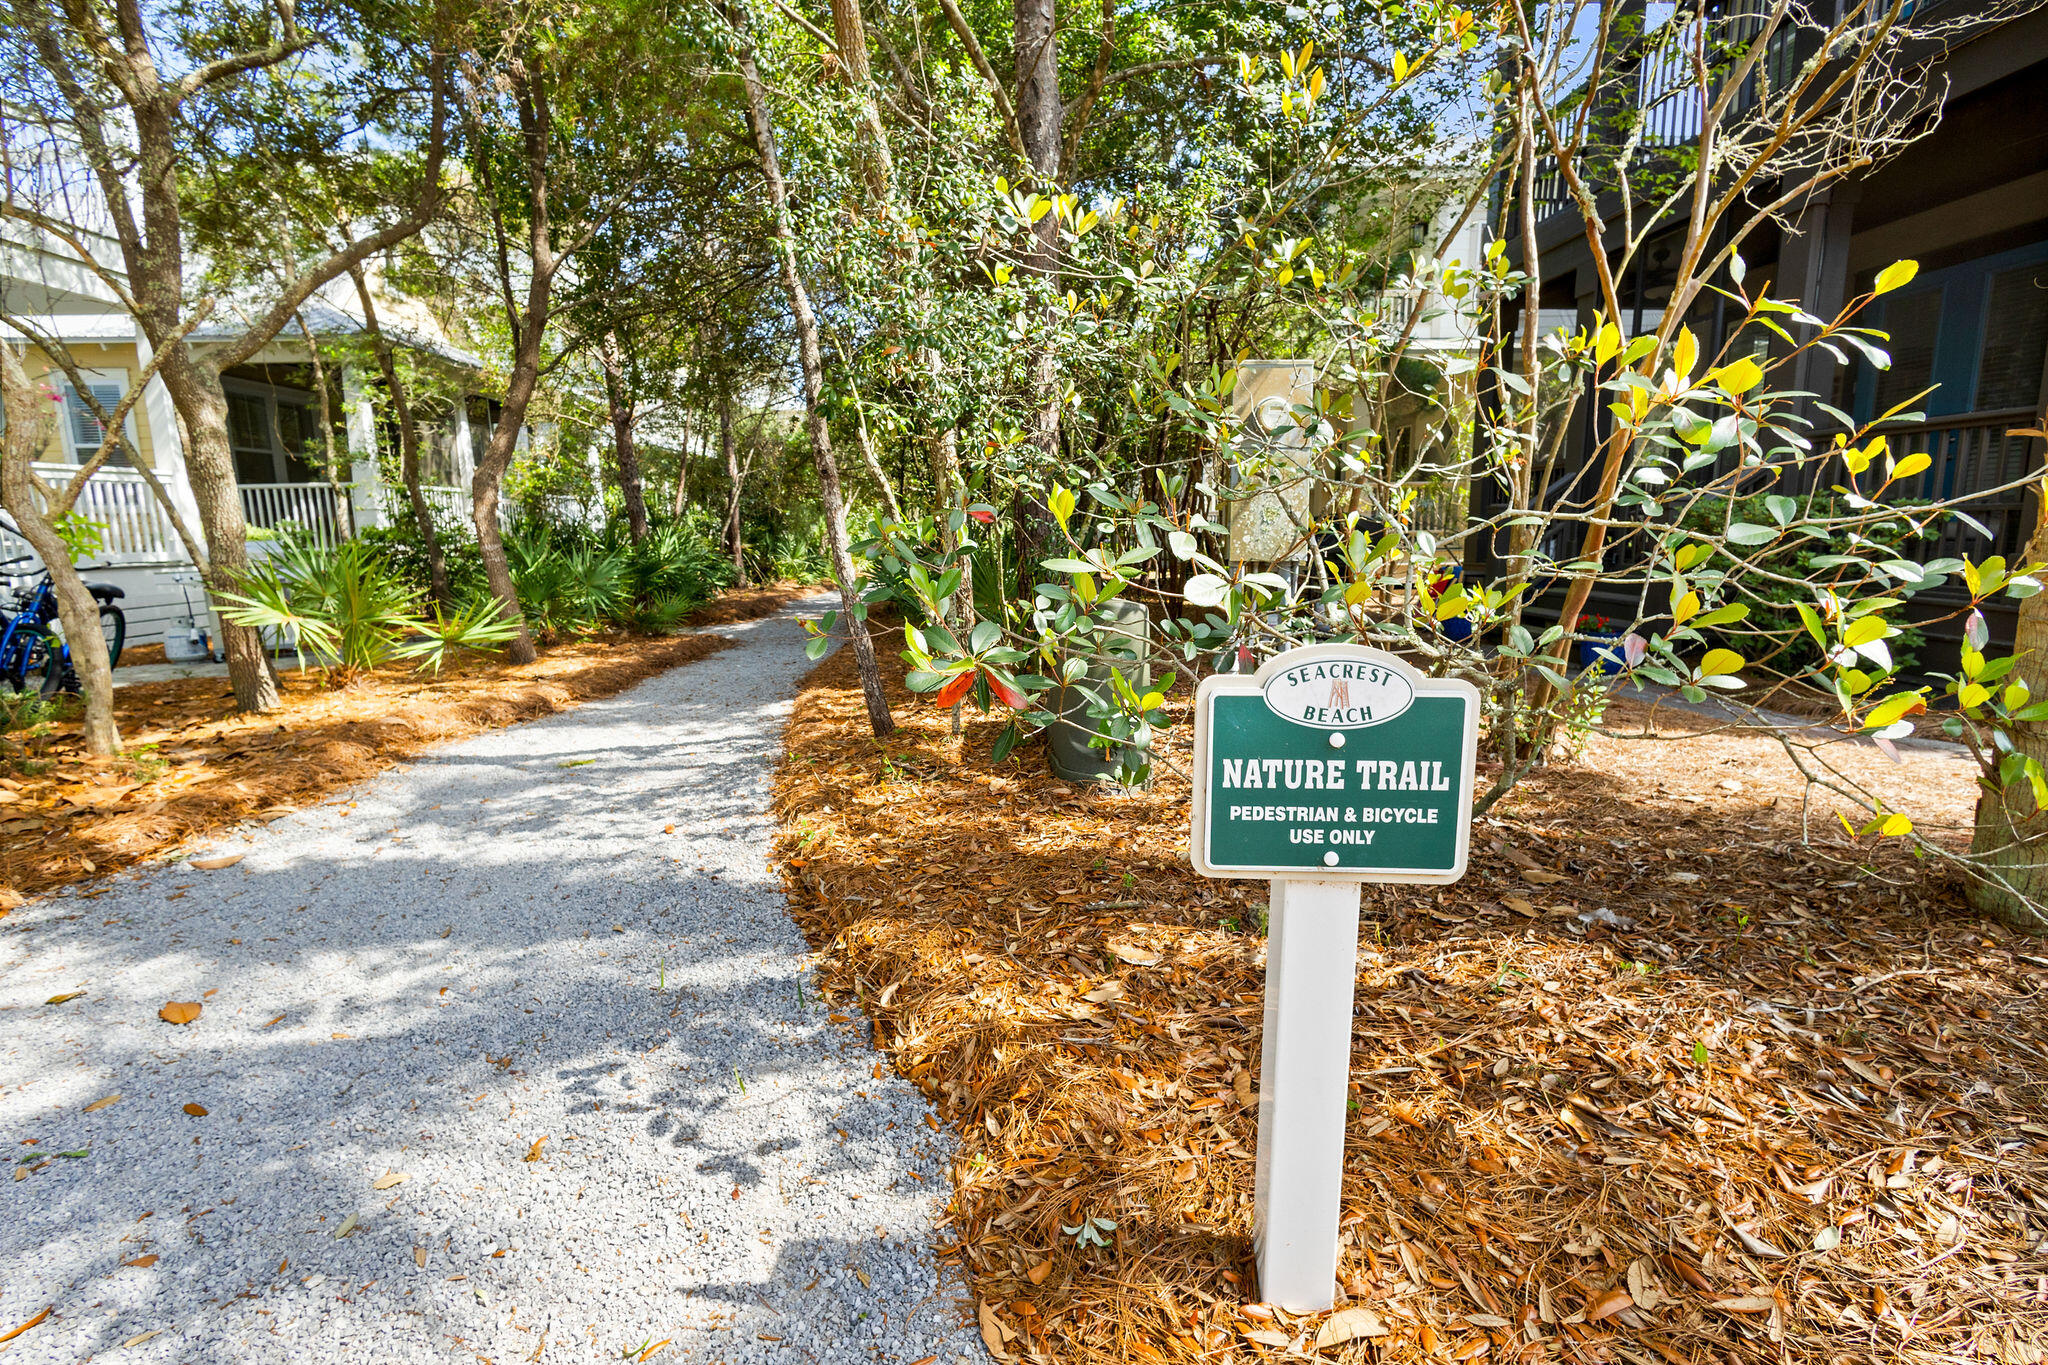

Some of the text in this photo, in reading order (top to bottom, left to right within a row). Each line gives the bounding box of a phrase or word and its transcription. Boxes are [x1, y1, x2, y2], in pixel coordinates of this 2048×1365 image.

[1287, 664, 1392, 687] SEACREST
[1303, 705, 1373, 723] BEACH
[1222, 758, 1450, 791] NATURE TRAIL
[1230, 805, 1438, 824] PEDESTRIAN & BICYCLE
[1289, 829, 1375, 844] USE ONLY
